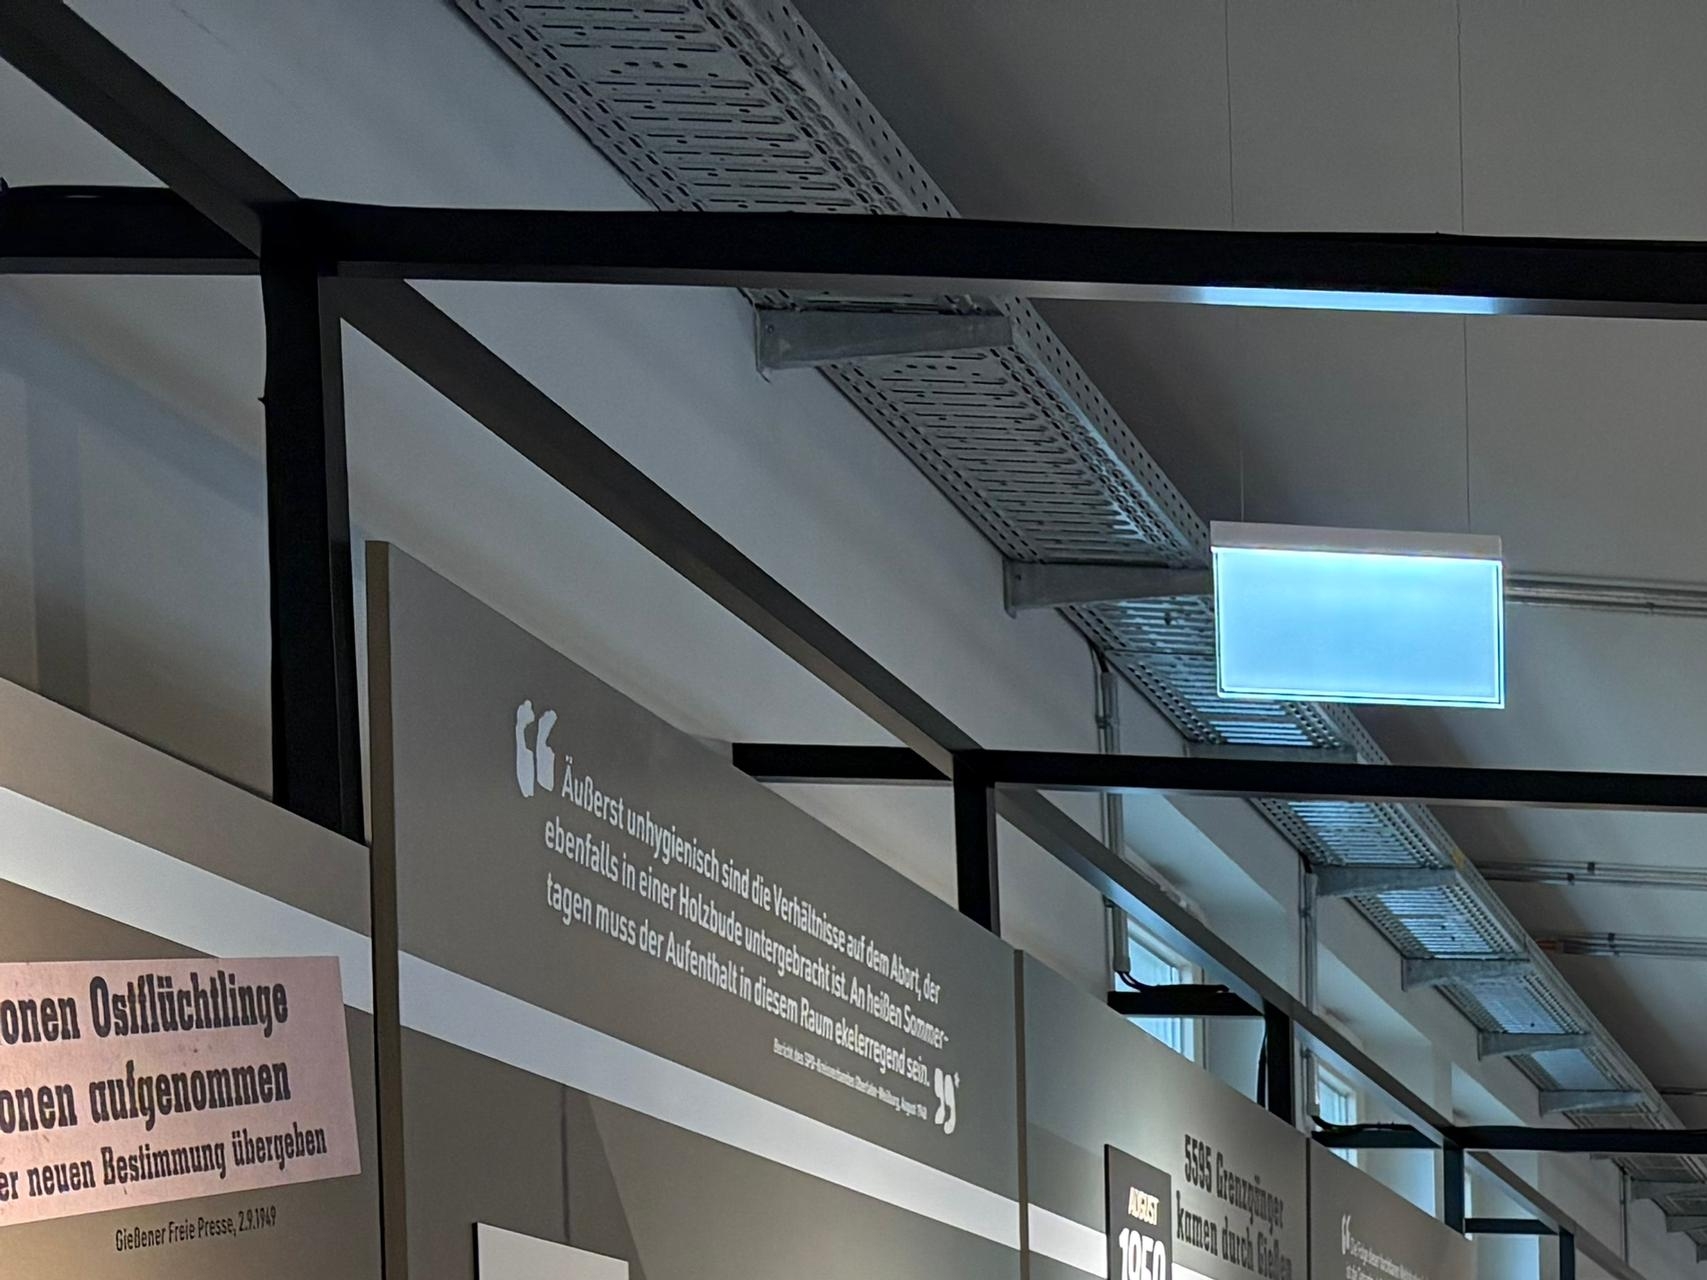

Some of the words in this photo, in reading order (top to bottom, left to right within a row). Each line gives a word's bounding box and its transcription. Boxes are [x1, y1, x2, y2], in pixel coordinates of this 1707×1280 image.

[562, 755, 624, 829] Äußerst
[627, 811, 719, 883] unhygienisch
[721, 859, 749, 899] sind
[752, 873, 771, 912] die
[773, 884, 845, 953] Verhältnisse
[846, 934, 866, 963] auf
[866, 940, 889, 978] dem
[889, 953, 921, 1001] Abort,
[923, 973, 941, 1004] der
[545, 816, 618, 882] ebenfalls
[622, 853, 635, 892] in
[639, 866, 677, 911] einer
[679, 882, 742, 946] Holzbude
[745, 926, 830, 995] untergebracht
[831, 965, 849, 1001] ist.
[850, 975, 866, 1010] An
[867, 984, 902, 1029] heißen
[903, 1004, 949, 1049] Sommer-
[89, 970, 288, 1038] Ostflüchtlinge
[547, 872, 592, 926] tagen
[596, 903, 637, 946] muss
[639, 919, 665, 958] der
[665, 931, 738, 994] Aufenthalt
[740, 967, 752, 1002] in
[754, 976, 798, 1024] diesem
[801, 996, 833, 1041] Raum
[835, 1017, 906, 1076] ekelerregend
[907, 1056, 930, 1088] sein.
[0, 1083, 78, 1134] onen
[88, 1060, 291, 1131] aufgenommen
[27, 1160, 96, 1197] neuen
[101, 1143, 226, 1185] Bestimmung
[232, 1121, 328, 1171] übergeben
[1216, 1152, 1284, 1235] Grenzgänger
[115, 1226, 166, 1252] Gießener
[169, 1218, 195, 1244] Freie
[197, 1216, 236, 1239] Presse,
[238, 1206, 276, 1231] 2.9.1949
[1128, 1186, 1160, 1225] AUGUST
[1176, 1190, 1218, 1257] kamen
[1221, 1216, 1254, 1272] durch
